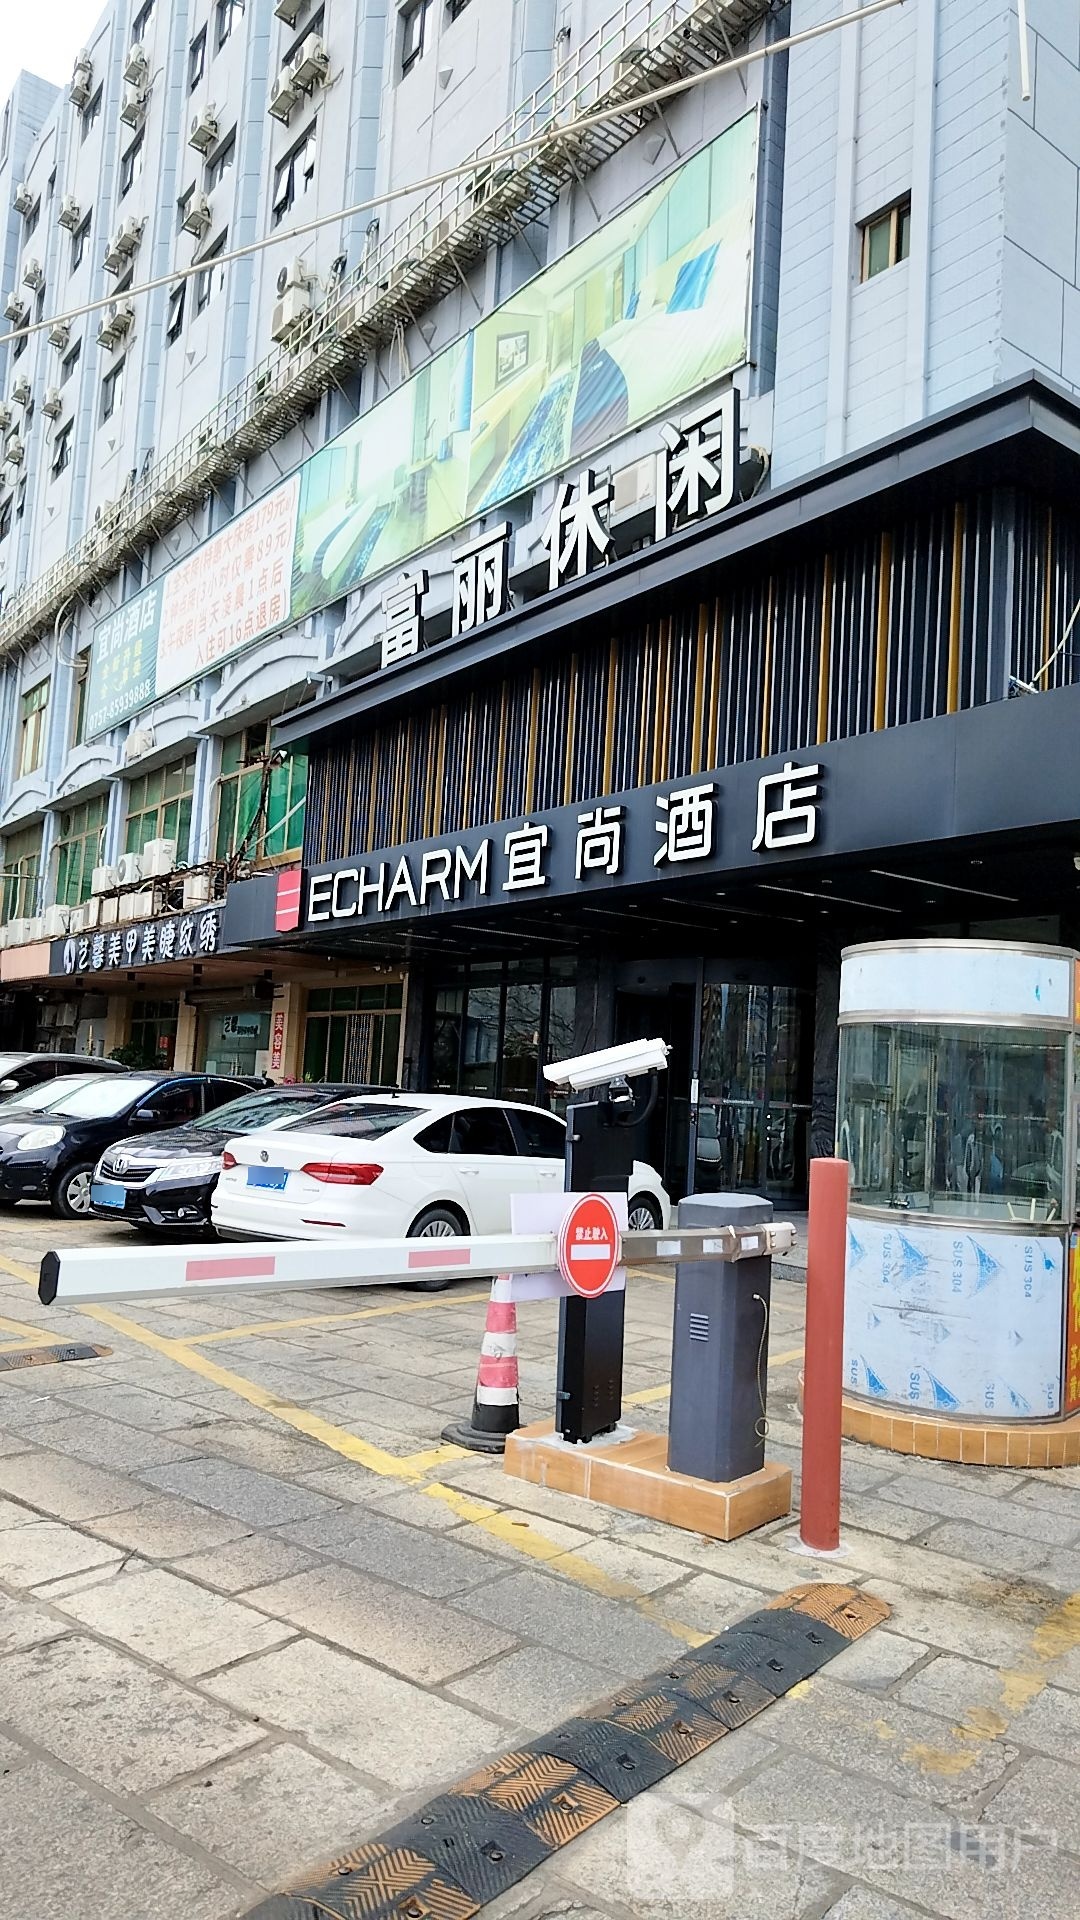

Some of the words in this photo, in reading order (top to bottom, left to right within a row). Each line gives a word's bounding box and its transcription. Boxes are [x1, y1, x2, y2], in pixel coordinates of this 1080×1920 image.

[380, 388, 740, 670] 富丽休闲
[96, 589, 158, 664] 宜尚酒店
[307, 839, 489, 923] ECHARM
[501, 761, 823, 893] 宜尚酒店
[78, 911, 218, 970] 艺馨美甲美睫纹绣
[576, 1227, 608, 1240] 禁止驶入
[952, 1240, 963, 1269] SUS
[1024, 1245, 1033, 1273] SUS
[952, 1271, 962, 1293] 304
[850, 1359, 859, 1384] SUS
[908, 1372, 920, 1400] SUS
